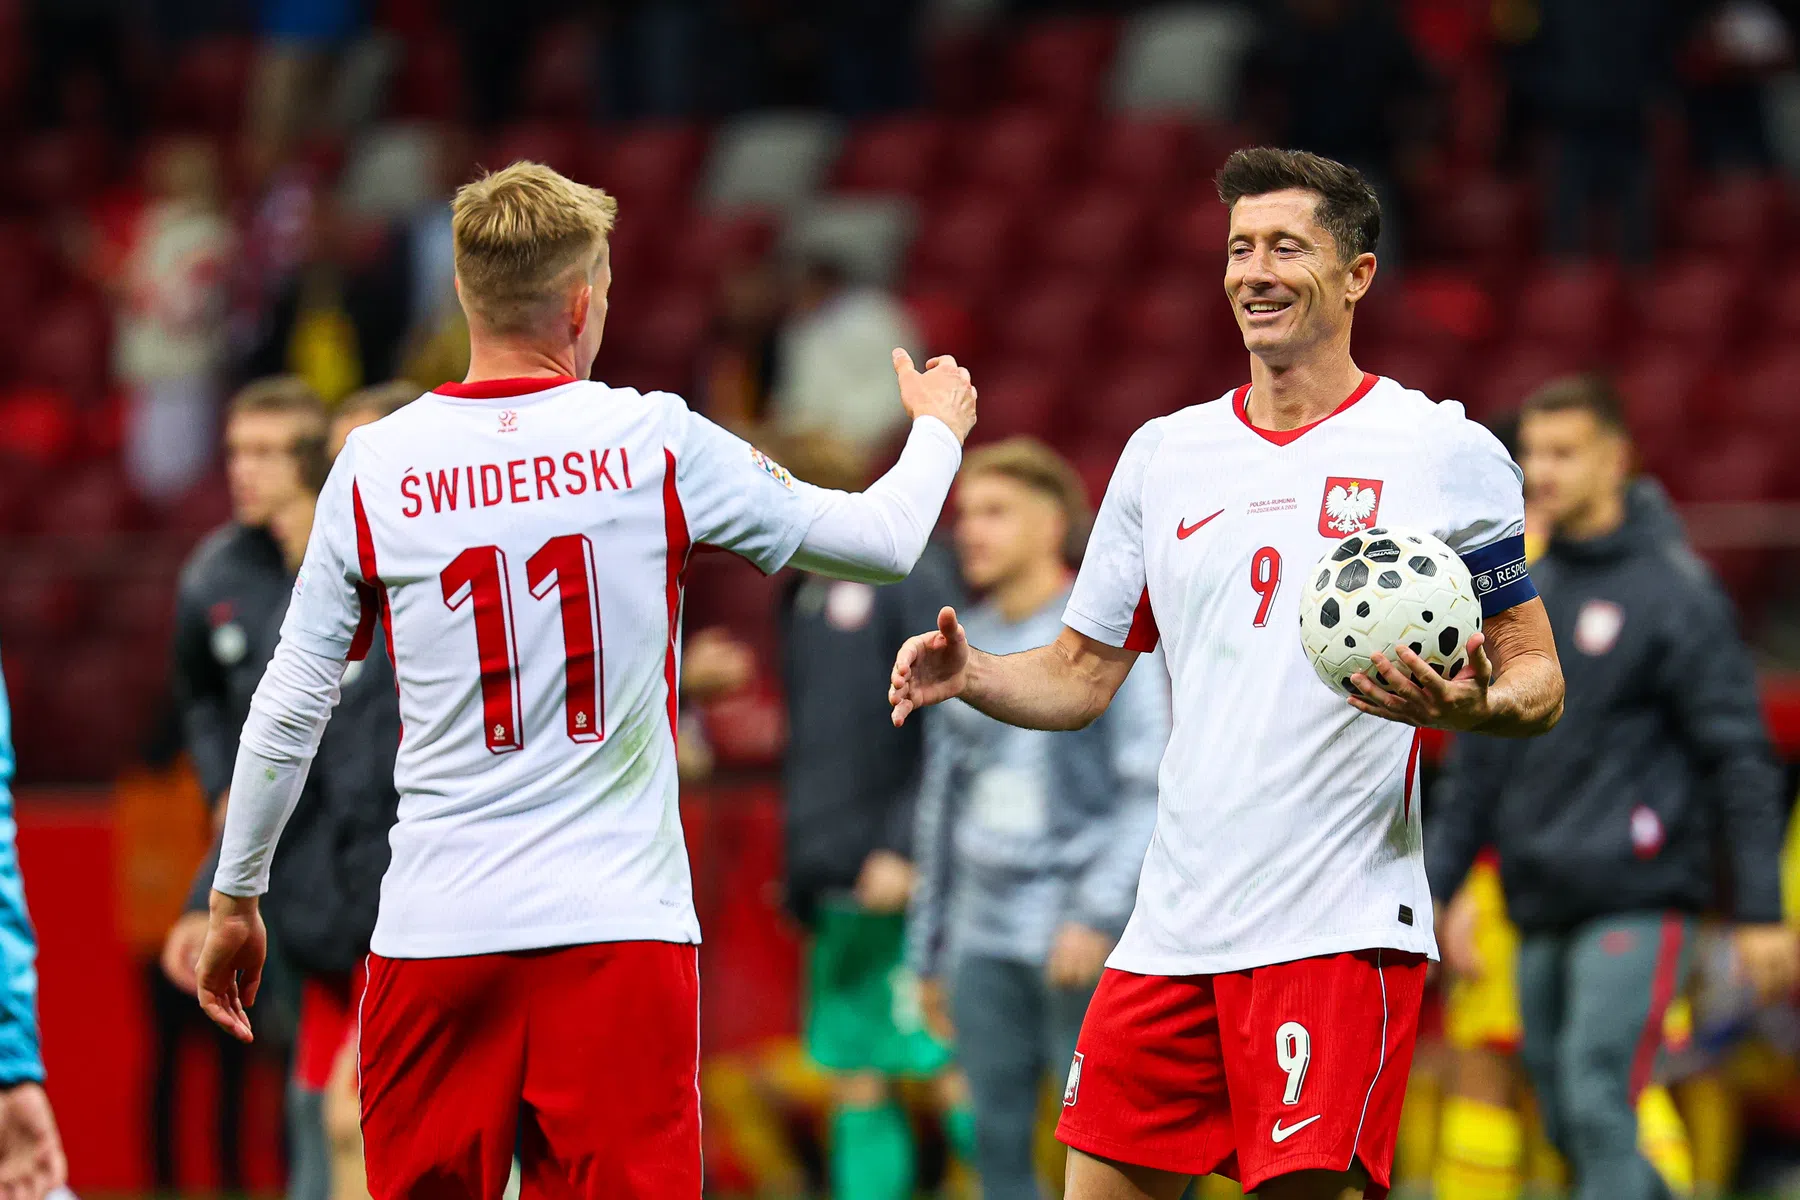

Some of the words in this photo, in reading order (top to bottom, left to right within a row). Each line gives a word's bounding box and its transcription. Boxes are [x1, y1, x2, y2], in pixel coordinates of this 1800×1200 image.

[401, 447, 633, 519] ŚWIDERSKI
[1250, 546, 1283, 629] 9
[1496, 561, 1527, 583] RESPEC
[440, 533, 605, 755] 11
[1275, 1021, 1312, 1105] 9
